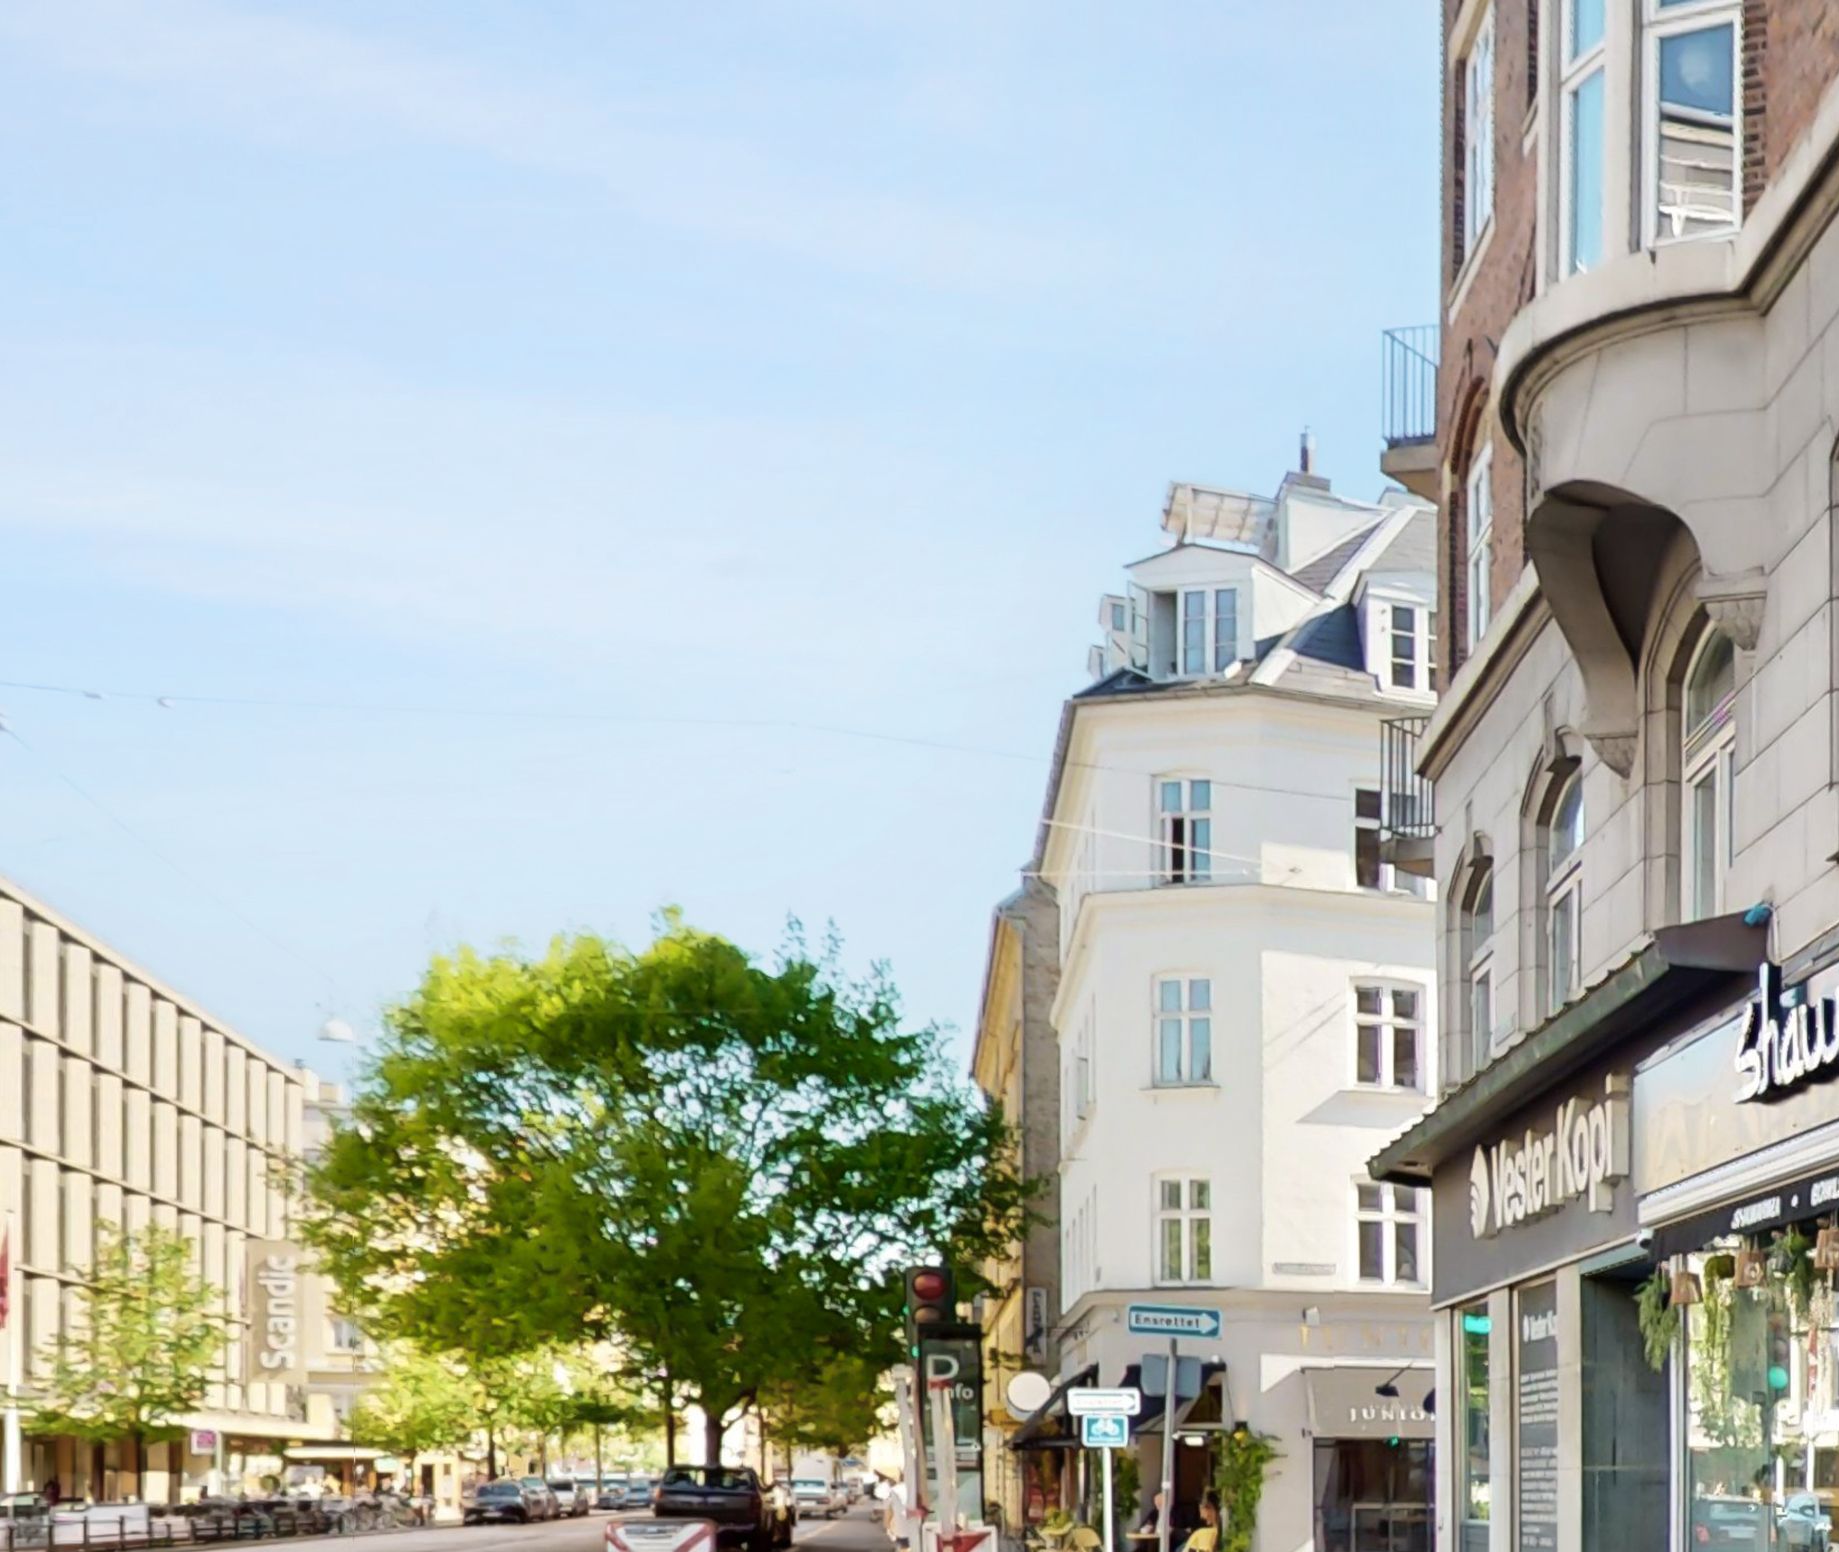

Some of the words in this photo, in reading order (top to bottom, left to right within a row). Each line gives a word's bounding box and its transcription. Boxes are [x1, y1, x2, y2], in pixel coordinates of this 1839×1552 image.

[1491, 1129, 1556, 1229] Vester
[1557, 1073, 1616, 1213] Kopi
[258, 1255, 296, 1369] Scandic
[1134, 1314, 1200, 1329] Ensrettet
